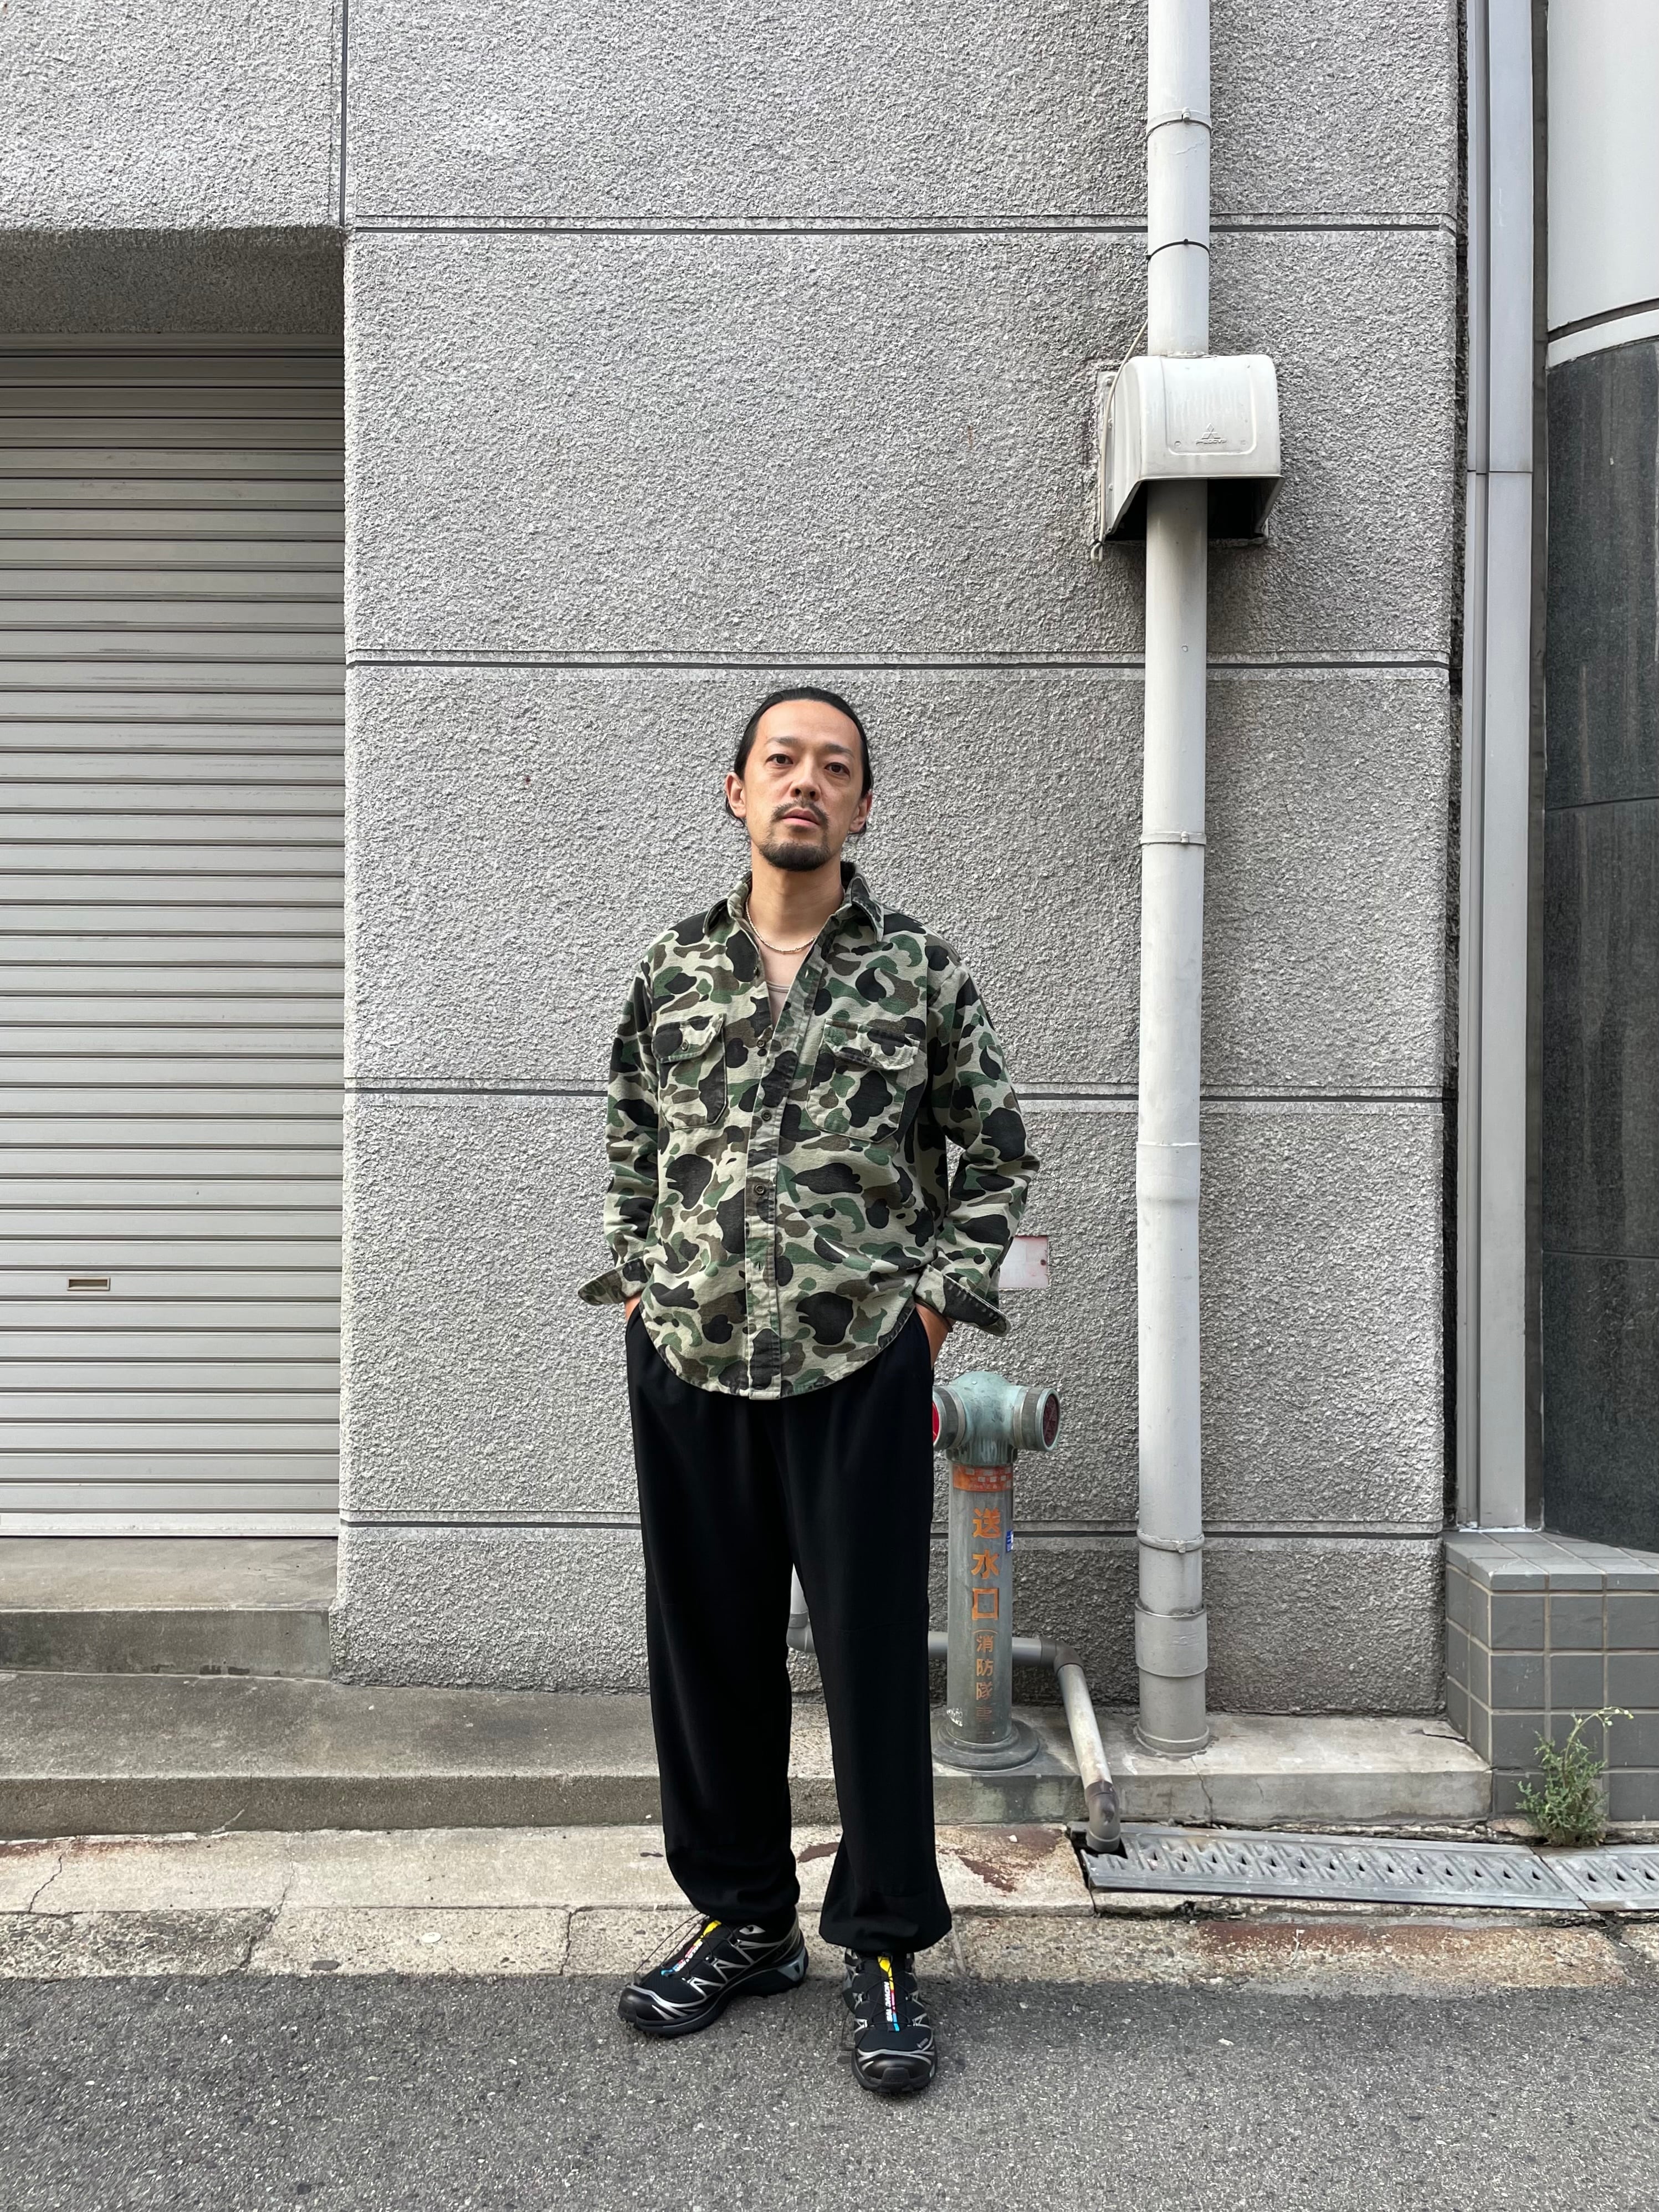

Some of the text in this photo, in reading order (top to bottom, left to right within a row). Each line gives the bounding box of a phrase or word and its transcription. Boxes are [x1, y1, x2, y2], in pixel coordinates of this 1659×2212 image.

[971, 1507, 1001, 1621] 送水口
[883, 1981, 893, 2022] SALOMON
